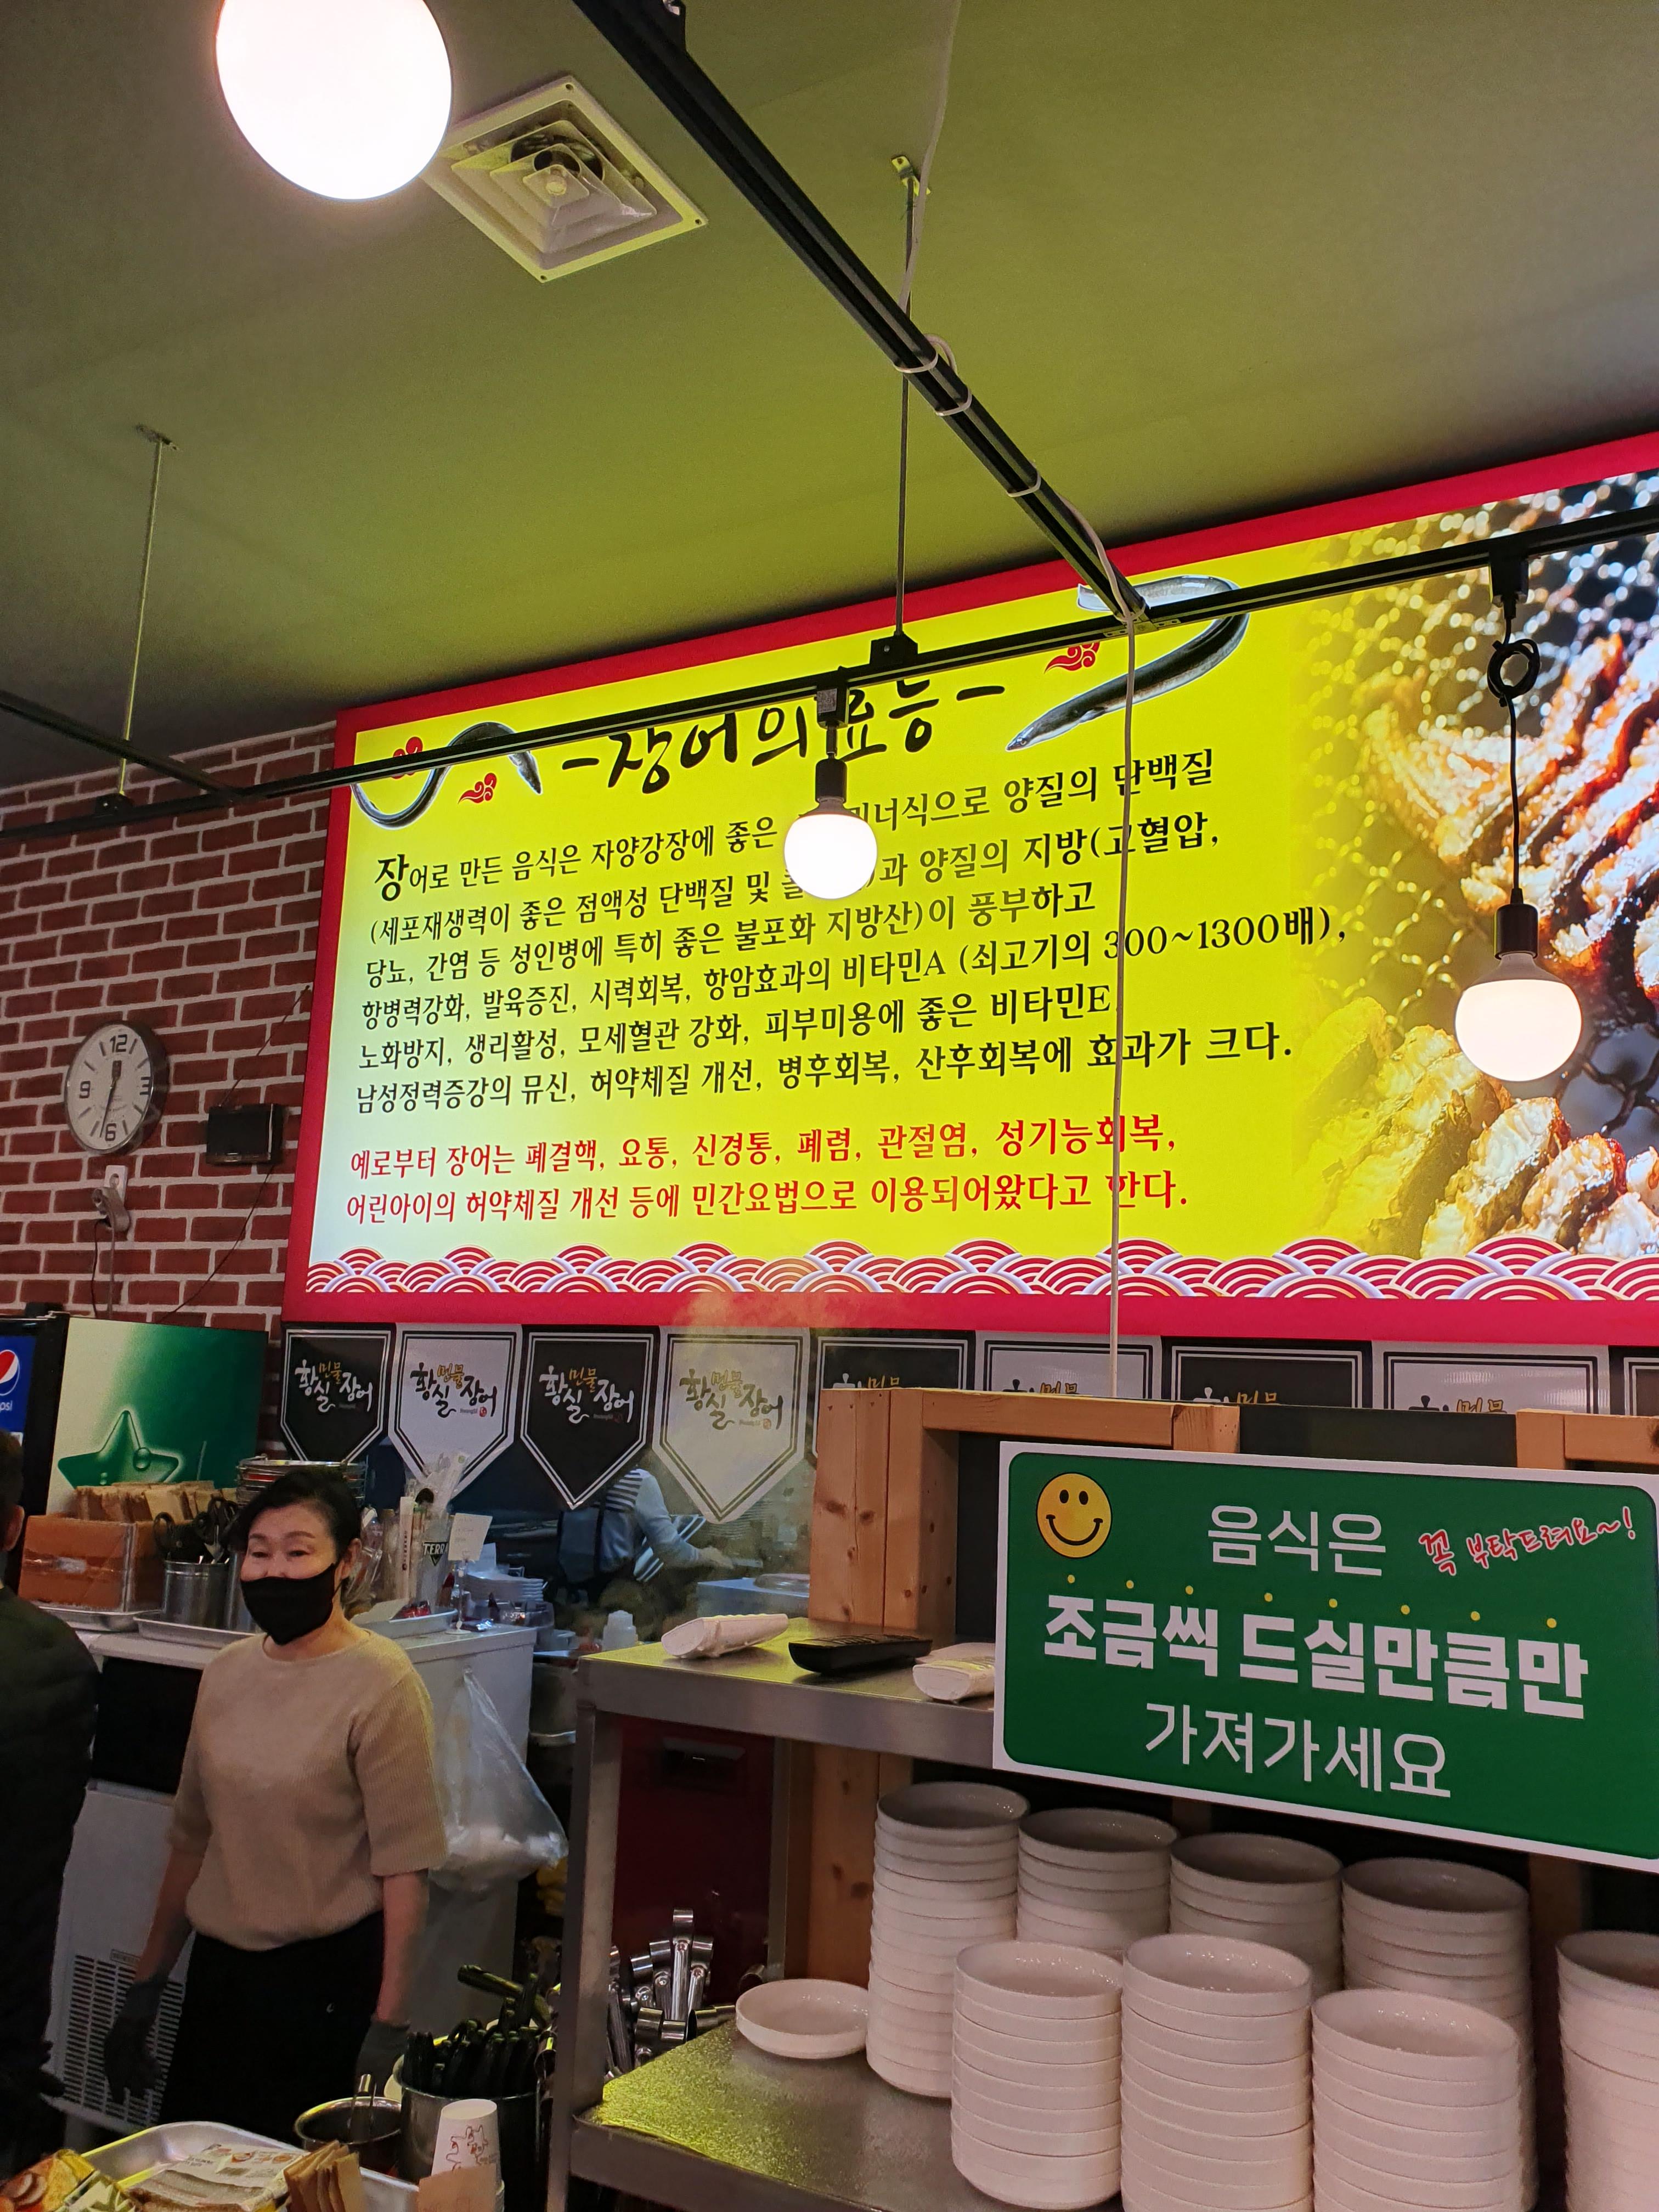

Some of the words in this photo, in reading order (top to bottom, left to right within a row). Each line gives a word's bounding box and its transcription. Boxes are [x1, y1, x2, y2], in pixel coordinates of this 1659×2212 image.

[374, 854, 449, 901] 장어로
[460, 856, 503, 887] 만든
[512, 844, 581, 881] 음식은
[591, 825, 713, 870] 자양강장에
[725, 816, 777, 853] 좋은
[1004, 766, 1096, 813] 양질의
[1113, 748, 1211, 794] 단백질
[371, 903, 509, 945] (세포재생력이
[520, 897, 565, 930] 좋은
[575, 887, 646, 923] 점액성
[659, 876, 732, 913] 단백질
[747, 871, 769, 904] 및
[920, 839, 1007, 882] 양질의
[1023, 811, 1217, 867] 지방(고혈압,
[367, 959, 413, 988] 당뇨,
[426, 950, 468, 981] 간염
[478, 948, 500, 977] 등
[510, 935, 602, 974] 성인병에
[614, 929, 661, 963] 특히
[673, 923, 723, 958] 좋은
[734, 912, 815, 951] 불포화
[827, 896, 953, 940] 지방산)이
[968, 882, 1095, 926] 풍부하고
[362, 993, 469, 1029] 항병력강화,
[483, 983, 575, 1019] 발육증진,
[590, 973, 690, 1009] 시력회복,
[703, 958, 829, 1000] 항암효과의
[843, 949, 945, 987] 비타민A
[960, 930, 1088, 975] (쇠고기의
[110, 1034, 128, 1053] 12
[357, 1075, 510, 1113] 남성정력증강의
[521, 1071, 575, 1104] 뮤신,
[590, 1063, 689, 1100] 허약체질
[701, 1059, 760, 1093] 개선,
[778, 1050, 898, 1088] 병후회복,
[916, 1036, 1070, 1080] 산후회복에
[1087, 1028, 1190, 1067] 효과가
[1205, 1022, 1290, 1059] 크다.
[359, 1037, 451, 1069] 노화방지,
[465, 1028, 564, 1064] 생리활성,
[578, 1018, 679, 1053] 모세혈관
[689, 1013, 748, 1048] 강화,
[765, 999, 903, 1041] 피부미용에
[917, 993, 977, 1031] 좋은
[79, 1081, 91, 1098] 9
[104, 1123, 117, 1142] 6
[351, 1147, 436, 1179] 예로부터
[446, 1144, 515, 1176] 장어는
[525, 1139, 603, 1173] 폐결핵,
[619, 1137, 676, 1169] 요통,
[692, 1132, 780, 1166] 신경통,
[797, 1127, 860, 1162] 폐렴,
[878, 1122, 977, 1159] 관절염,
[996, 1114, 1174, 1156] 성기능회복,
[347, 1192, 455, 1224] 어린아이의
[466, 1188, 558, 1221] 허약체질
[570, 1186, 618, 1219] 개선
[629, 1184, 679, 1218] 등에
[693, 1180, 856, 1215] 민간요법으로
[871, 1173, 1091, 1212] 이용되어왔다고
[1105, 1170, 1186, 1208] 한다.
[1207, 1505, 1386, 1576] 음식은
[1418, 1529, 1457, 1576] 꼭
[1044, 1594, 1218, 1677] 조금씩
[1239, 1614, 1589, 1719] 드실만큼만
[1145, 1703, 1452, 1798] 가져가세요
